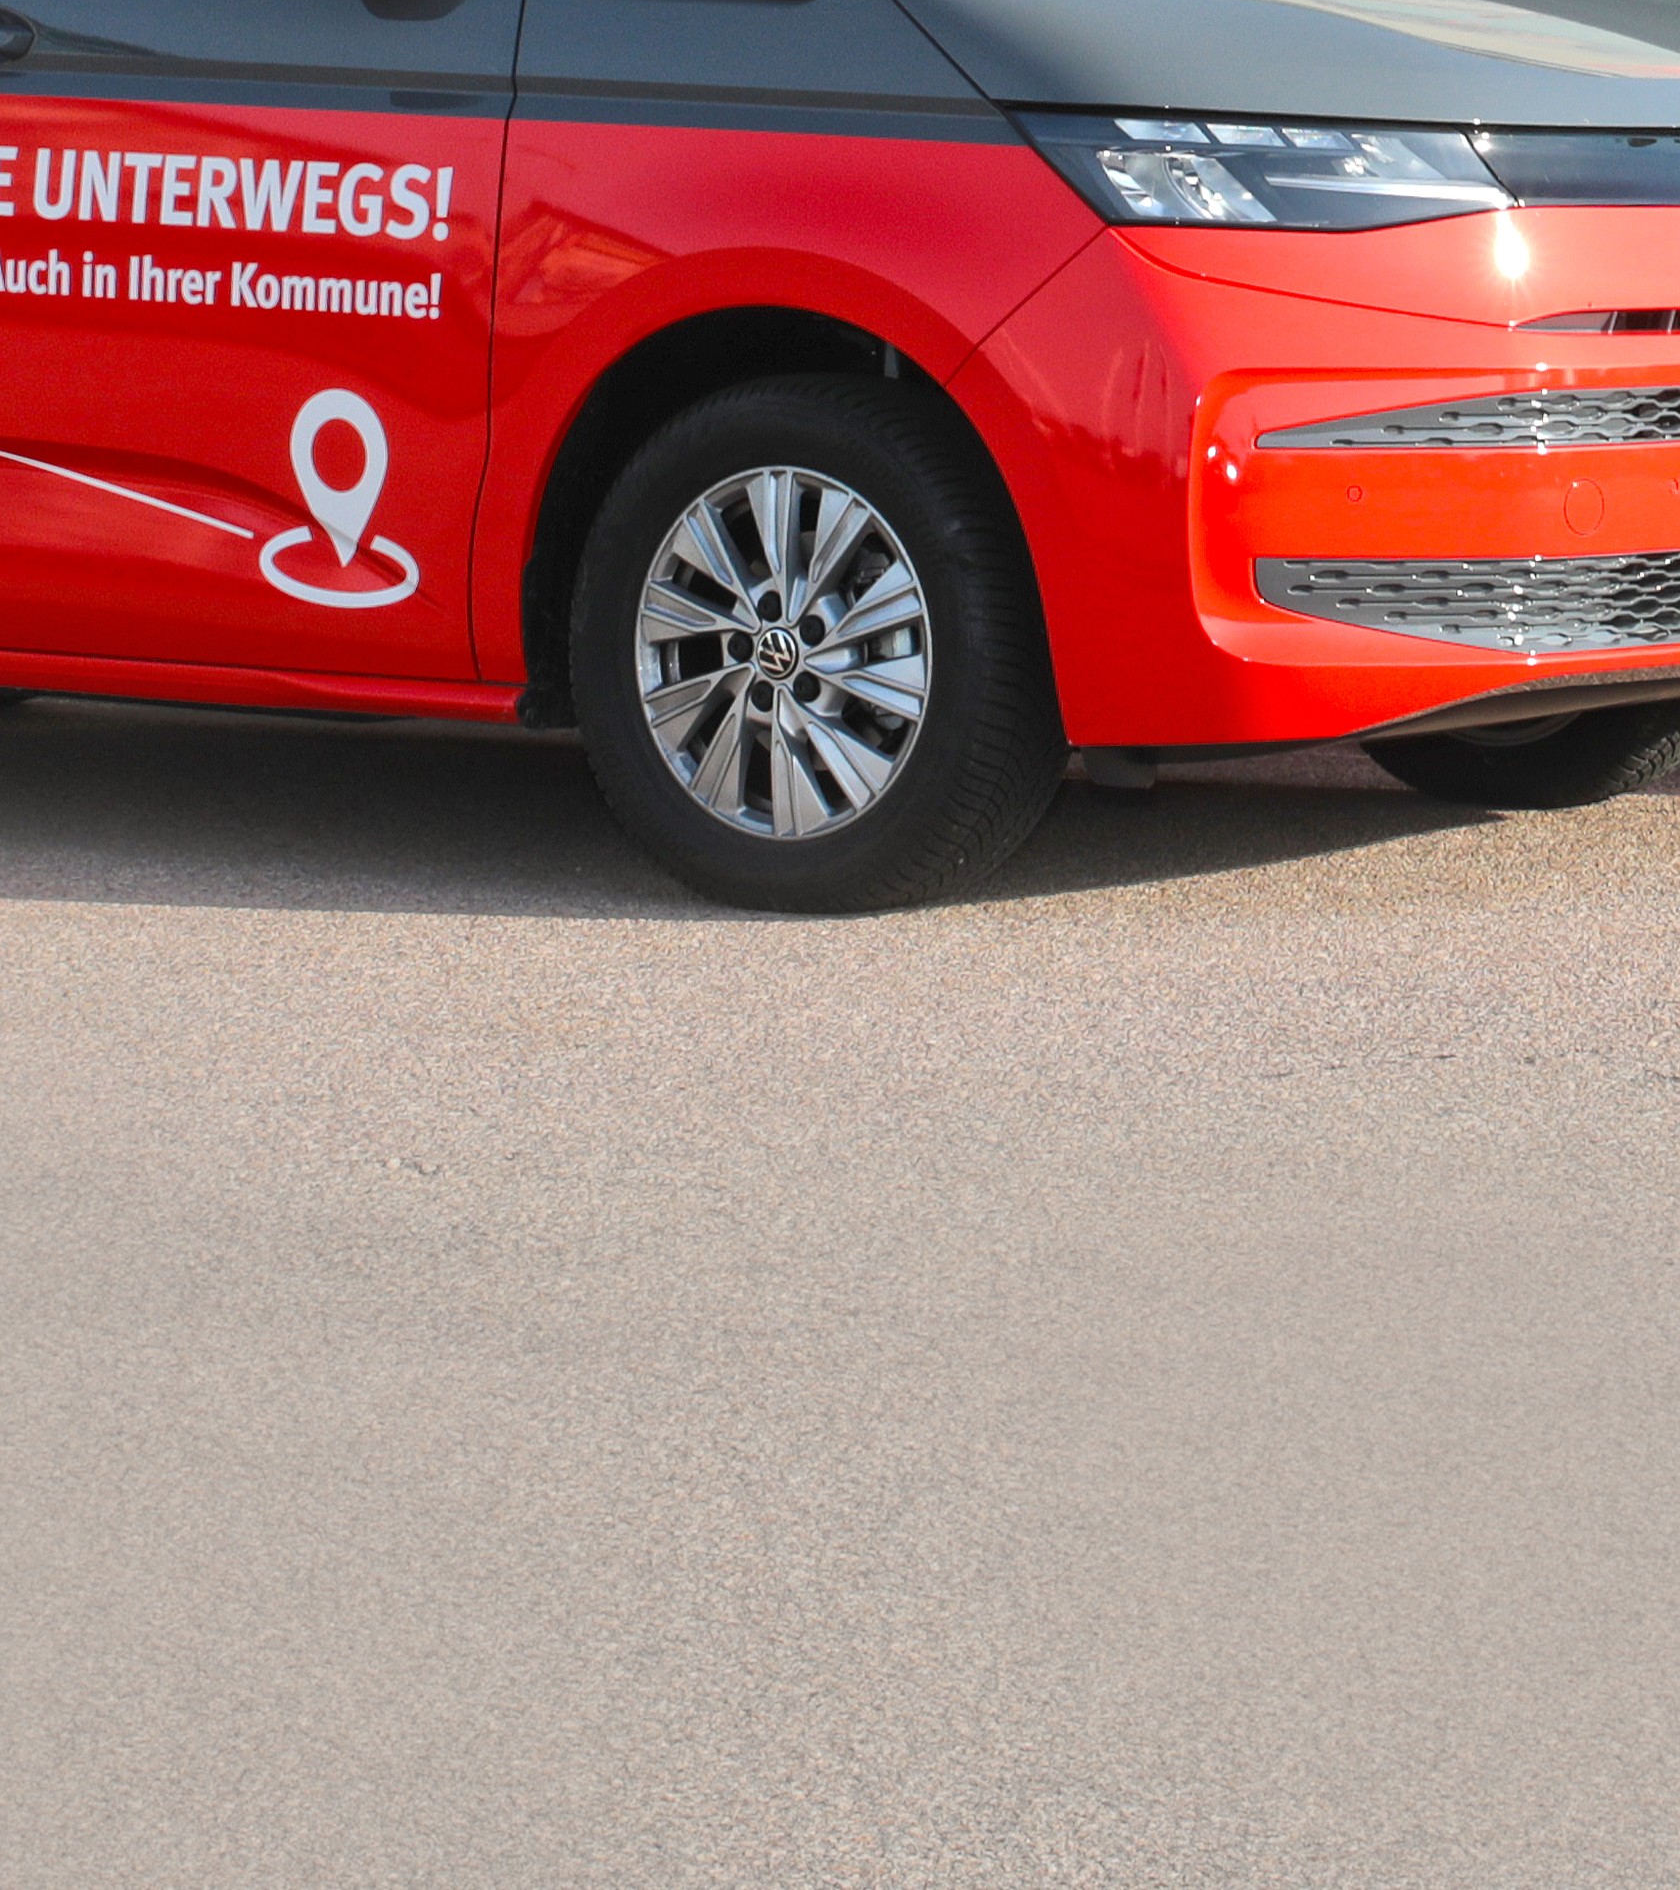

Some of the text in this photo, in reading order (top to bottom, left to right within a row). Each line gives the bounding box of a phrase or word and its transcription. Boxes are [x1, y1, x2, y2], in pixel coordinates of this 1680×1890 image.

[33, 147, 455, 243] UNTERWEGS!
[82, 251, 117, 299] in
[128, 254, 222, 305] Ihrer
[230, 262, 442, 321] Kommune!
